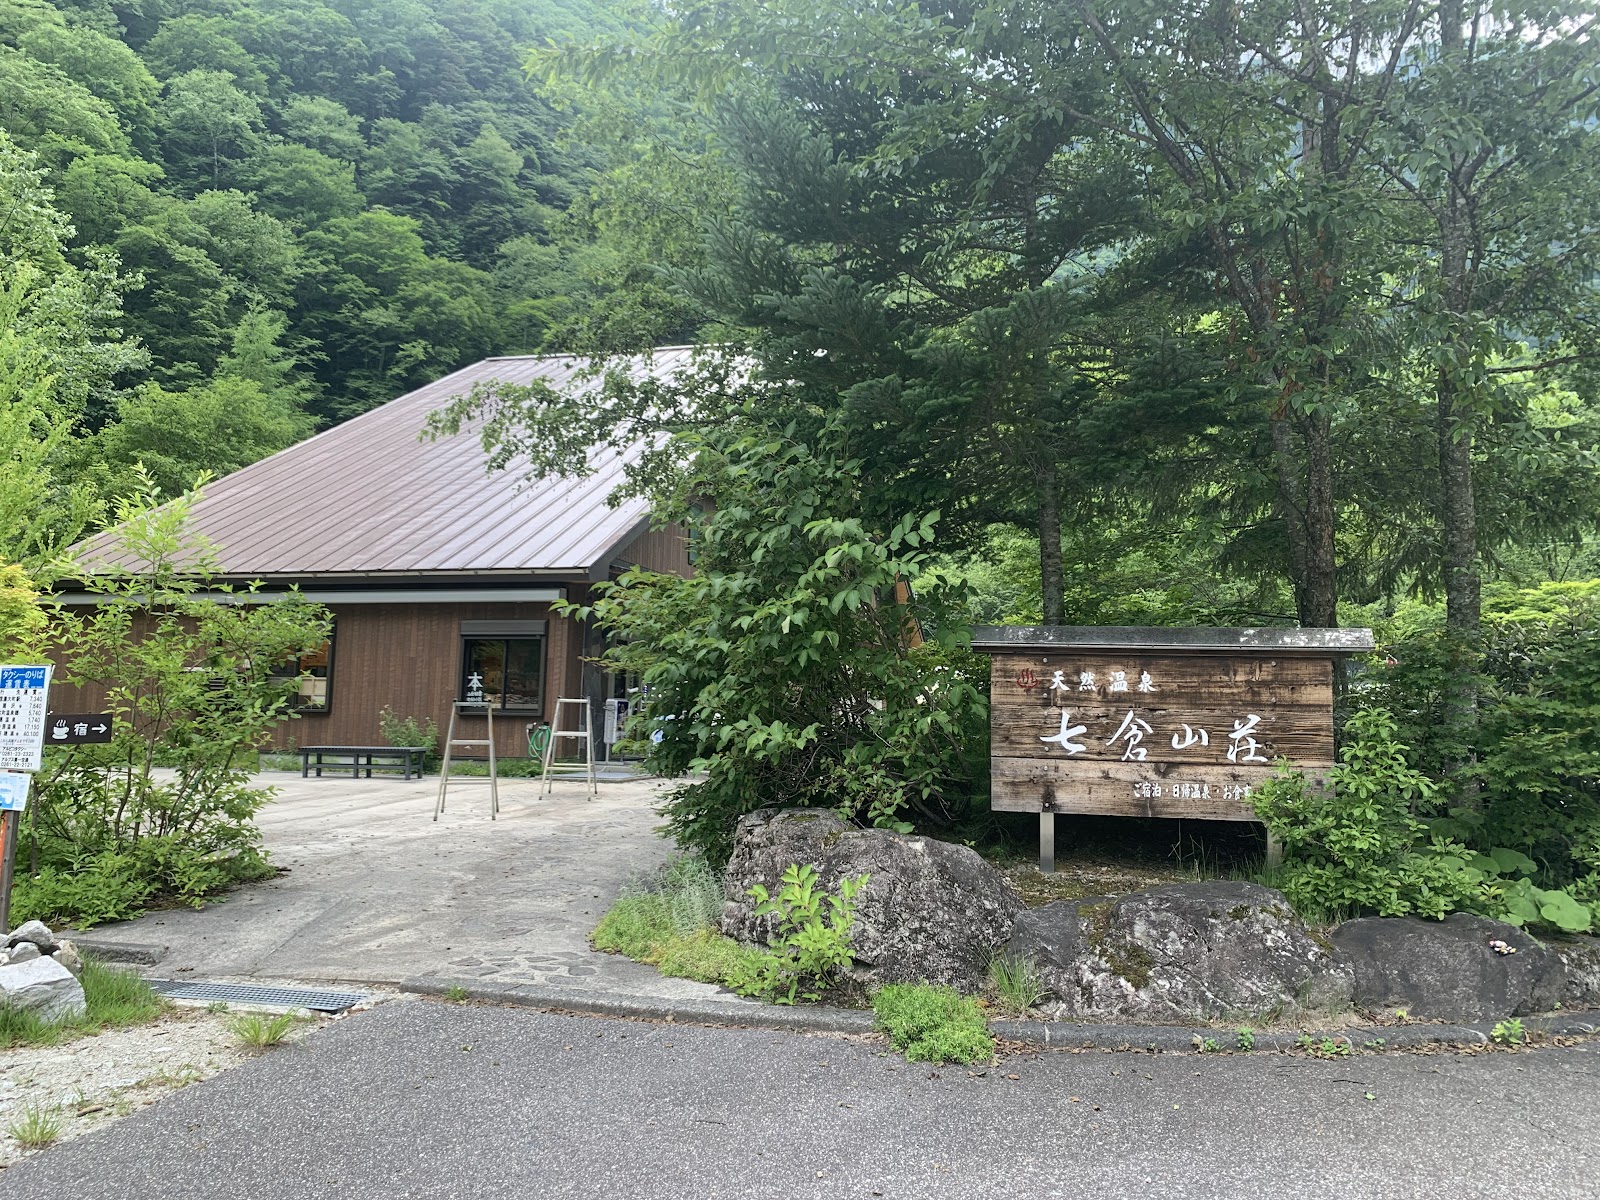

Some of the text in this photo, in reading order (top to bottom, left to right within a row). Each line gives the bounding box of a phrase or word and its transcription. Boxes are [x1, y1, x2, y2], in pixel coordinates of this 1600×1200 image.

[3, 670, 44, 679] タクシーのりば
[467, 671, 483, 691] 本
[1049, 670, 1158, 693] 天然温泉
[73, 722, 88, 736] 宿
[1039, 709, 1269, 763] 七倉山荘
